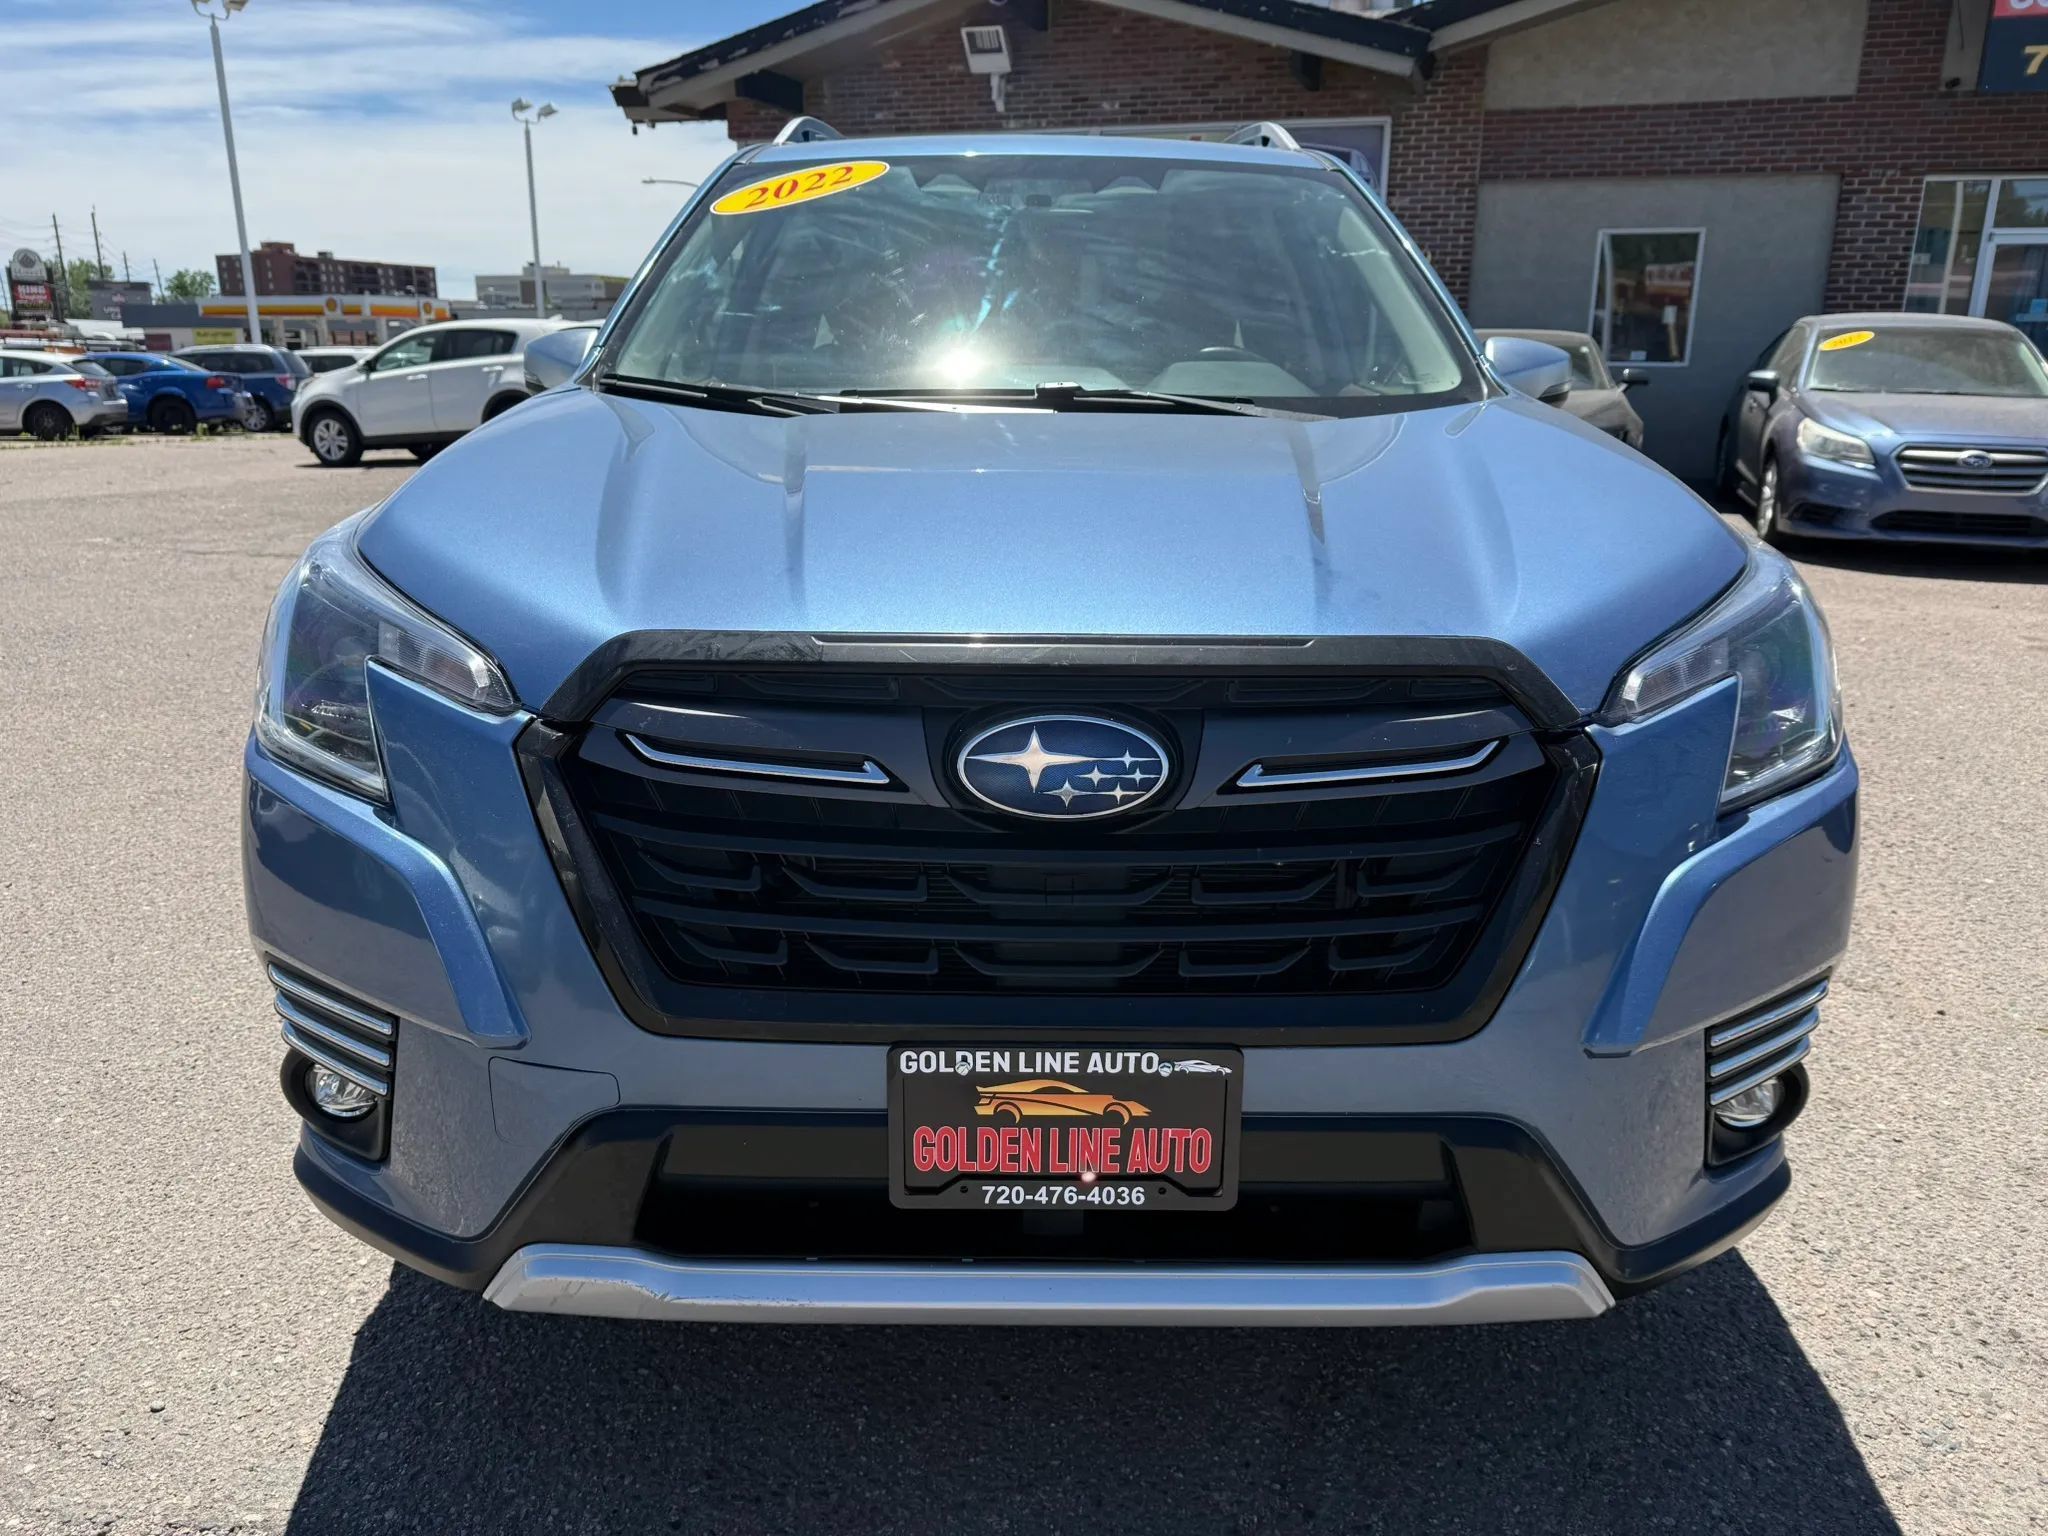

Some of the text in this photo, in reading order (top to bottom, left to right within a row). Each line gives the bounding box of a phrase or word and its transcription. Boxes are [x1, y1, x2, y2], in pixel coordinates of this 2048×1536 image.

[745, 166, 853, 208] 2022
[900, 1051, 1160, 1074] GOLDEN LINE AUTO
[913, 1125, 1212, 1174] GOLDEN LINE AUTO
[981, 1185, 1145, 1206] 720-476-4036
